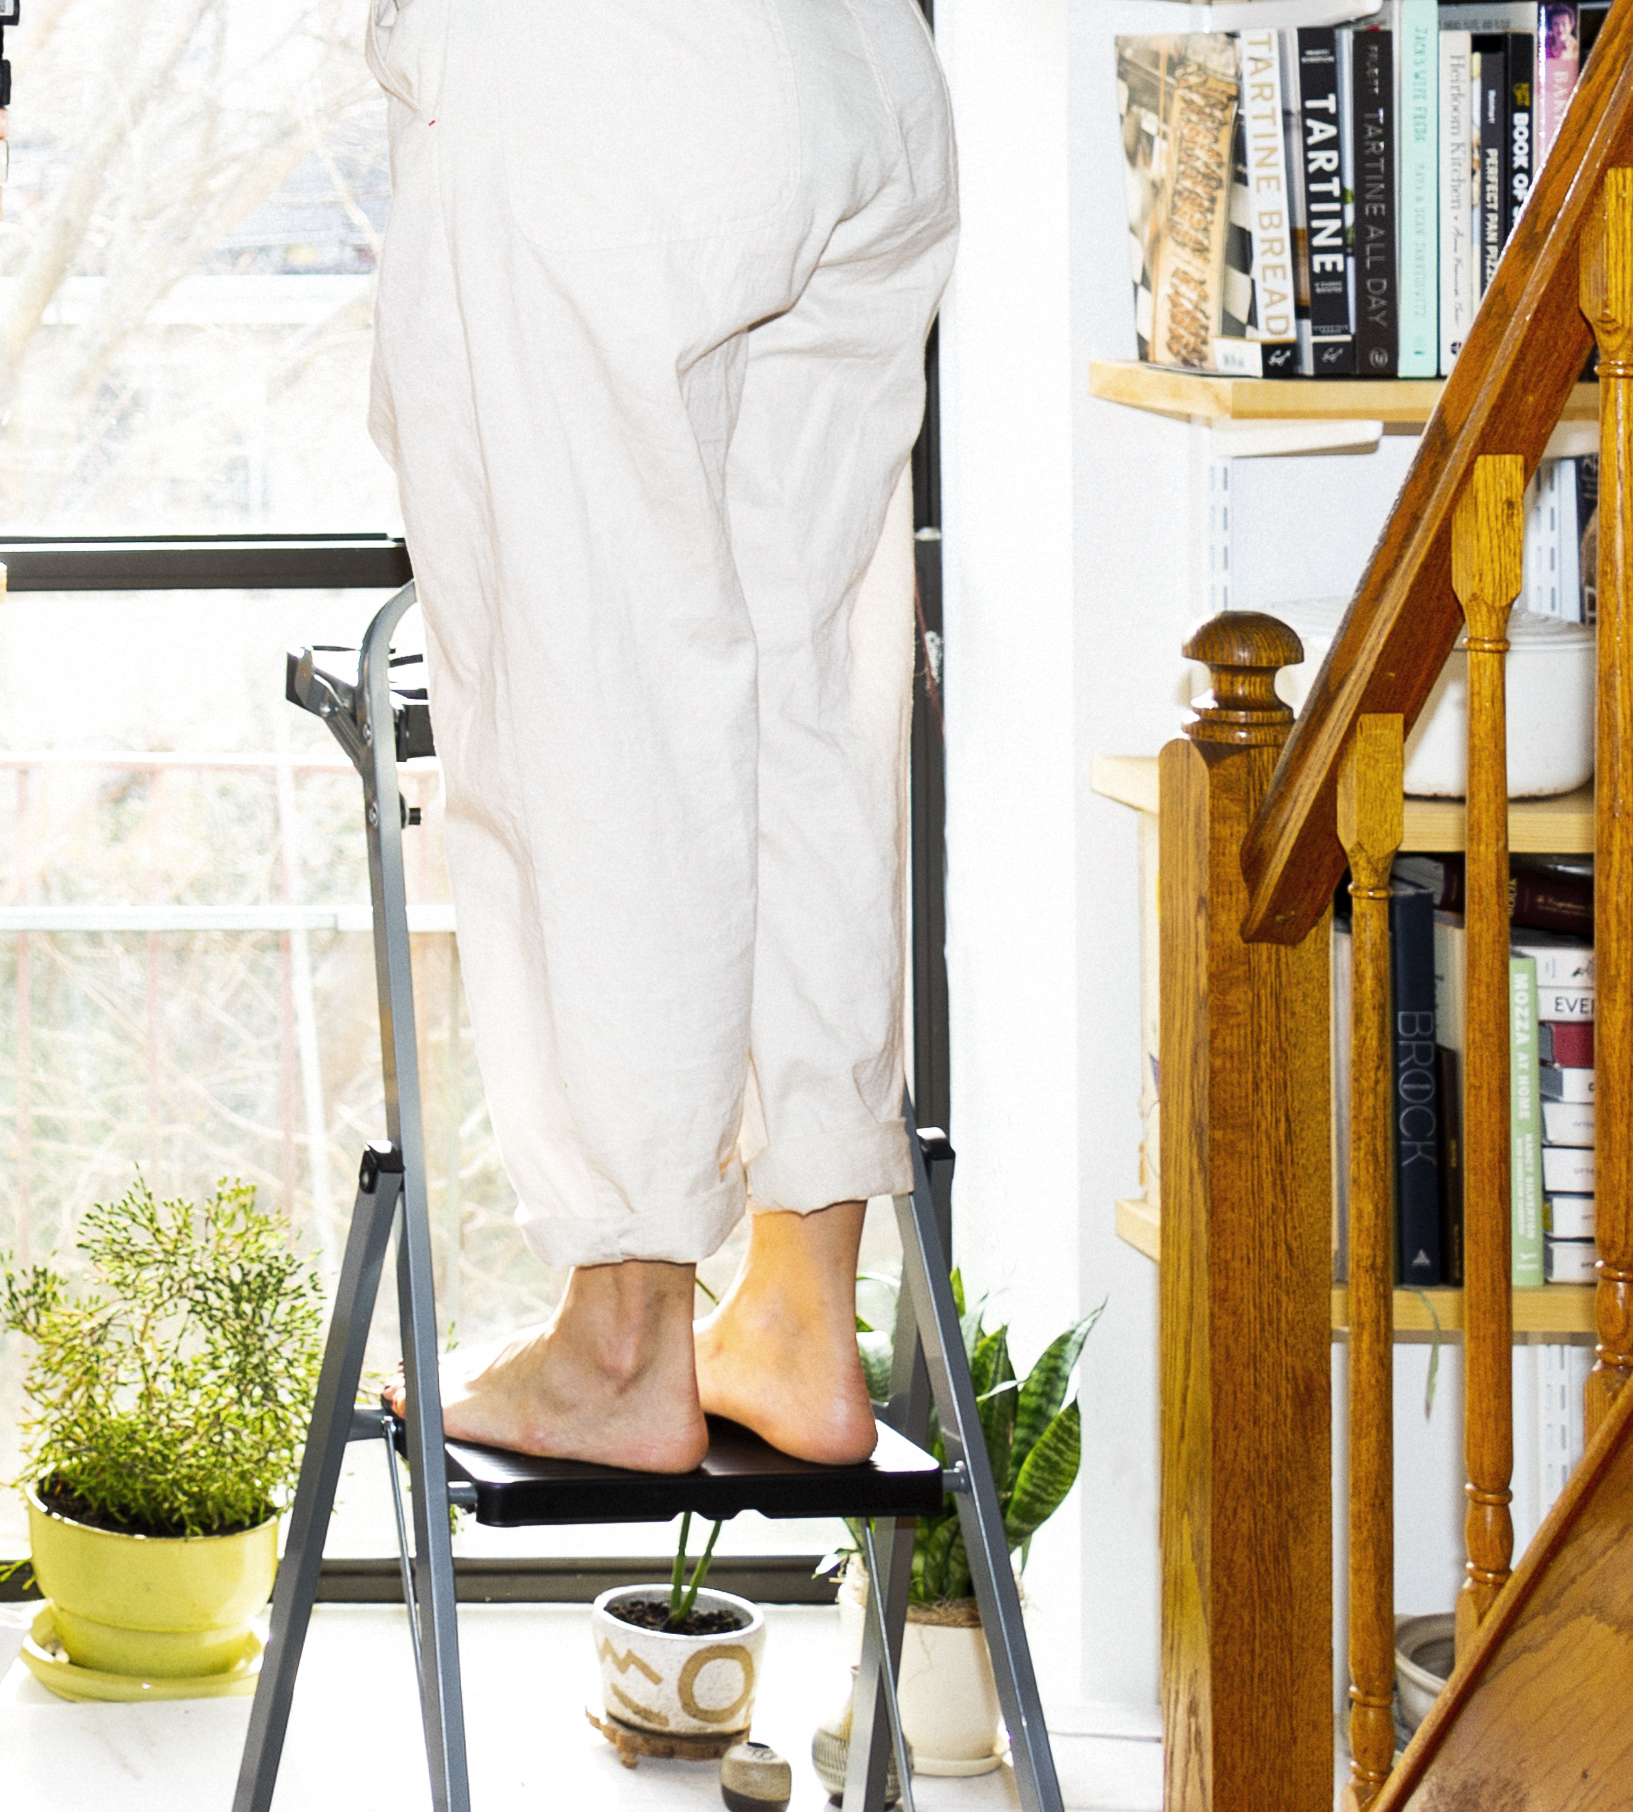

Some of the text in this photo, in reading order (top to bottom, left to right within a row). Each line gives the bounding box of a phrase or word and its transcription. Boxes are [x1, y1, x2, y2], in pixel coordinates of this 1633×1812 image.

[1248, 35, 1290, 337] TARTINE BREAD
[1304, 95, 1344, 273] TARTINE
